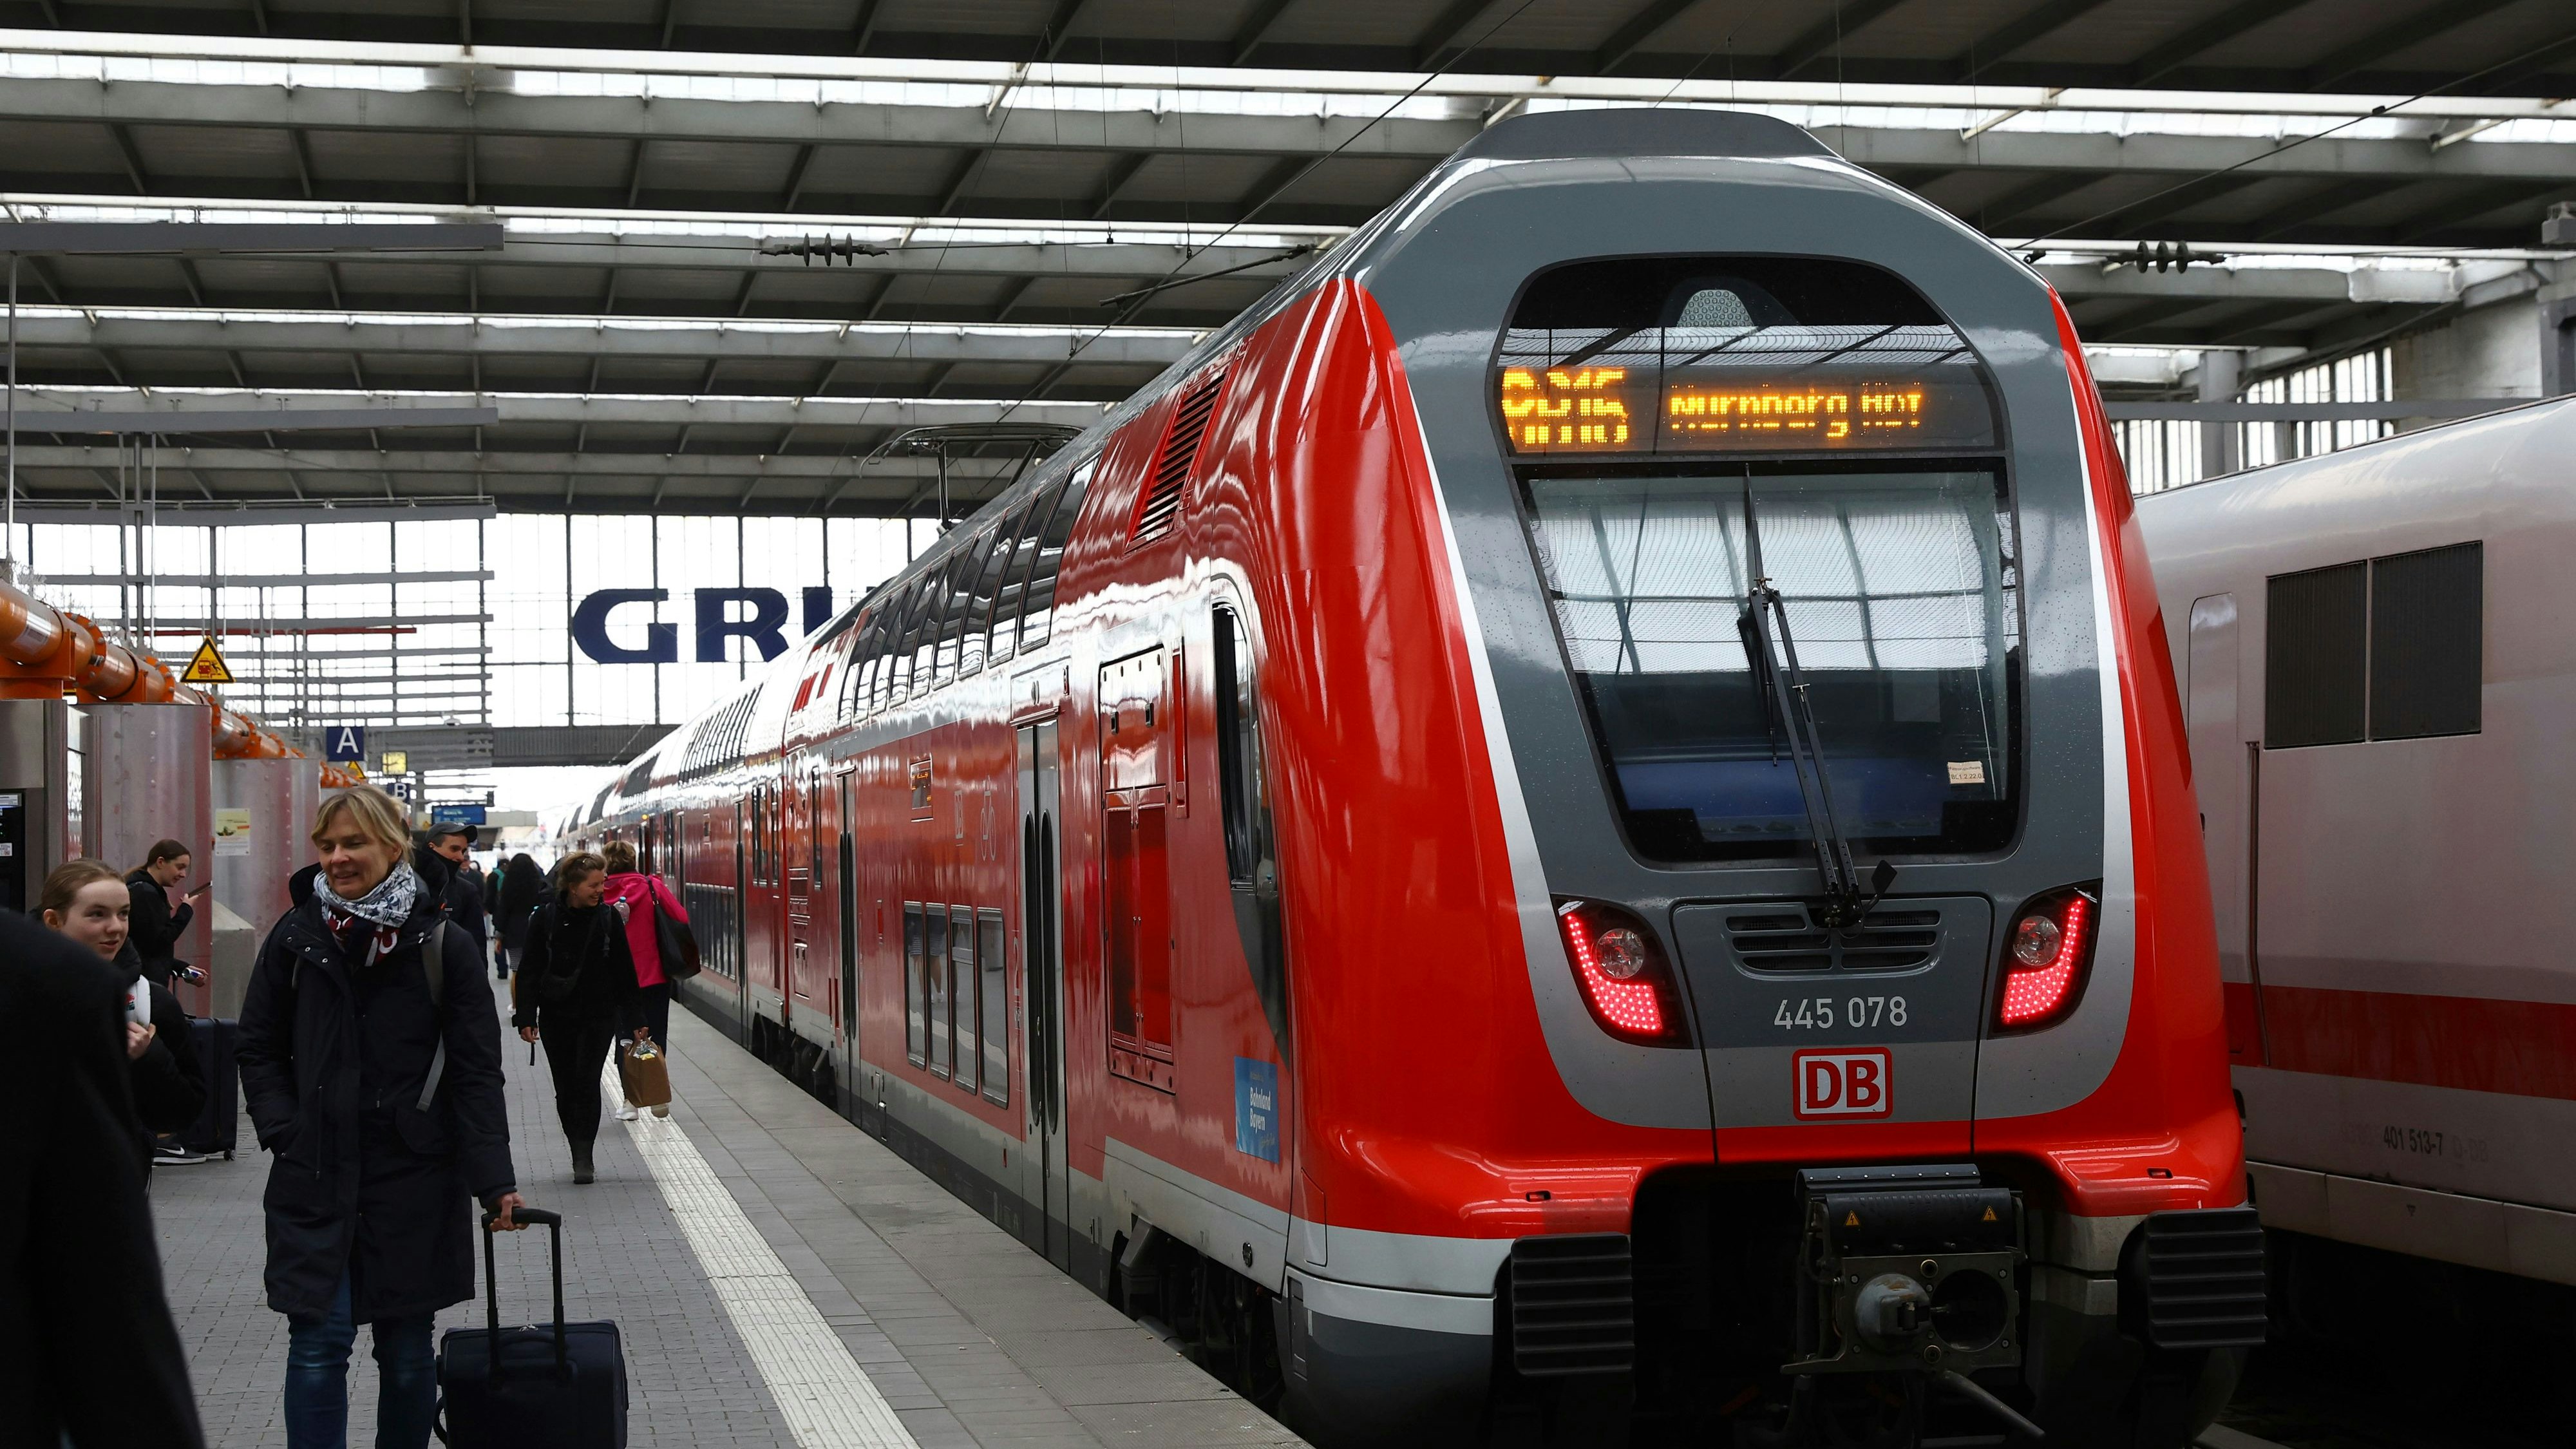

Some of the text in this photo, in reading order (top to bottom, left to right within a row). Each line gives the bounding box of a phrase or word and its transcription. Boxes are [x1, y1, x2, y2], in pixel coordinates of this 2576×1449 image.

[336, 727, 359, 753] A
[393, 783, 408, 800] B
[1774, 996, 1908, 1030] 445 078
[1805, 1059, 1881, 1110] DB
[1250, 1086, 1271, 1111] Bahnland
[1250, 1108, 1265, 1133] Bayern
[2383, 1126, 2405, 1151] 401
[2409, 1128, 2443, 1156] 513-7
